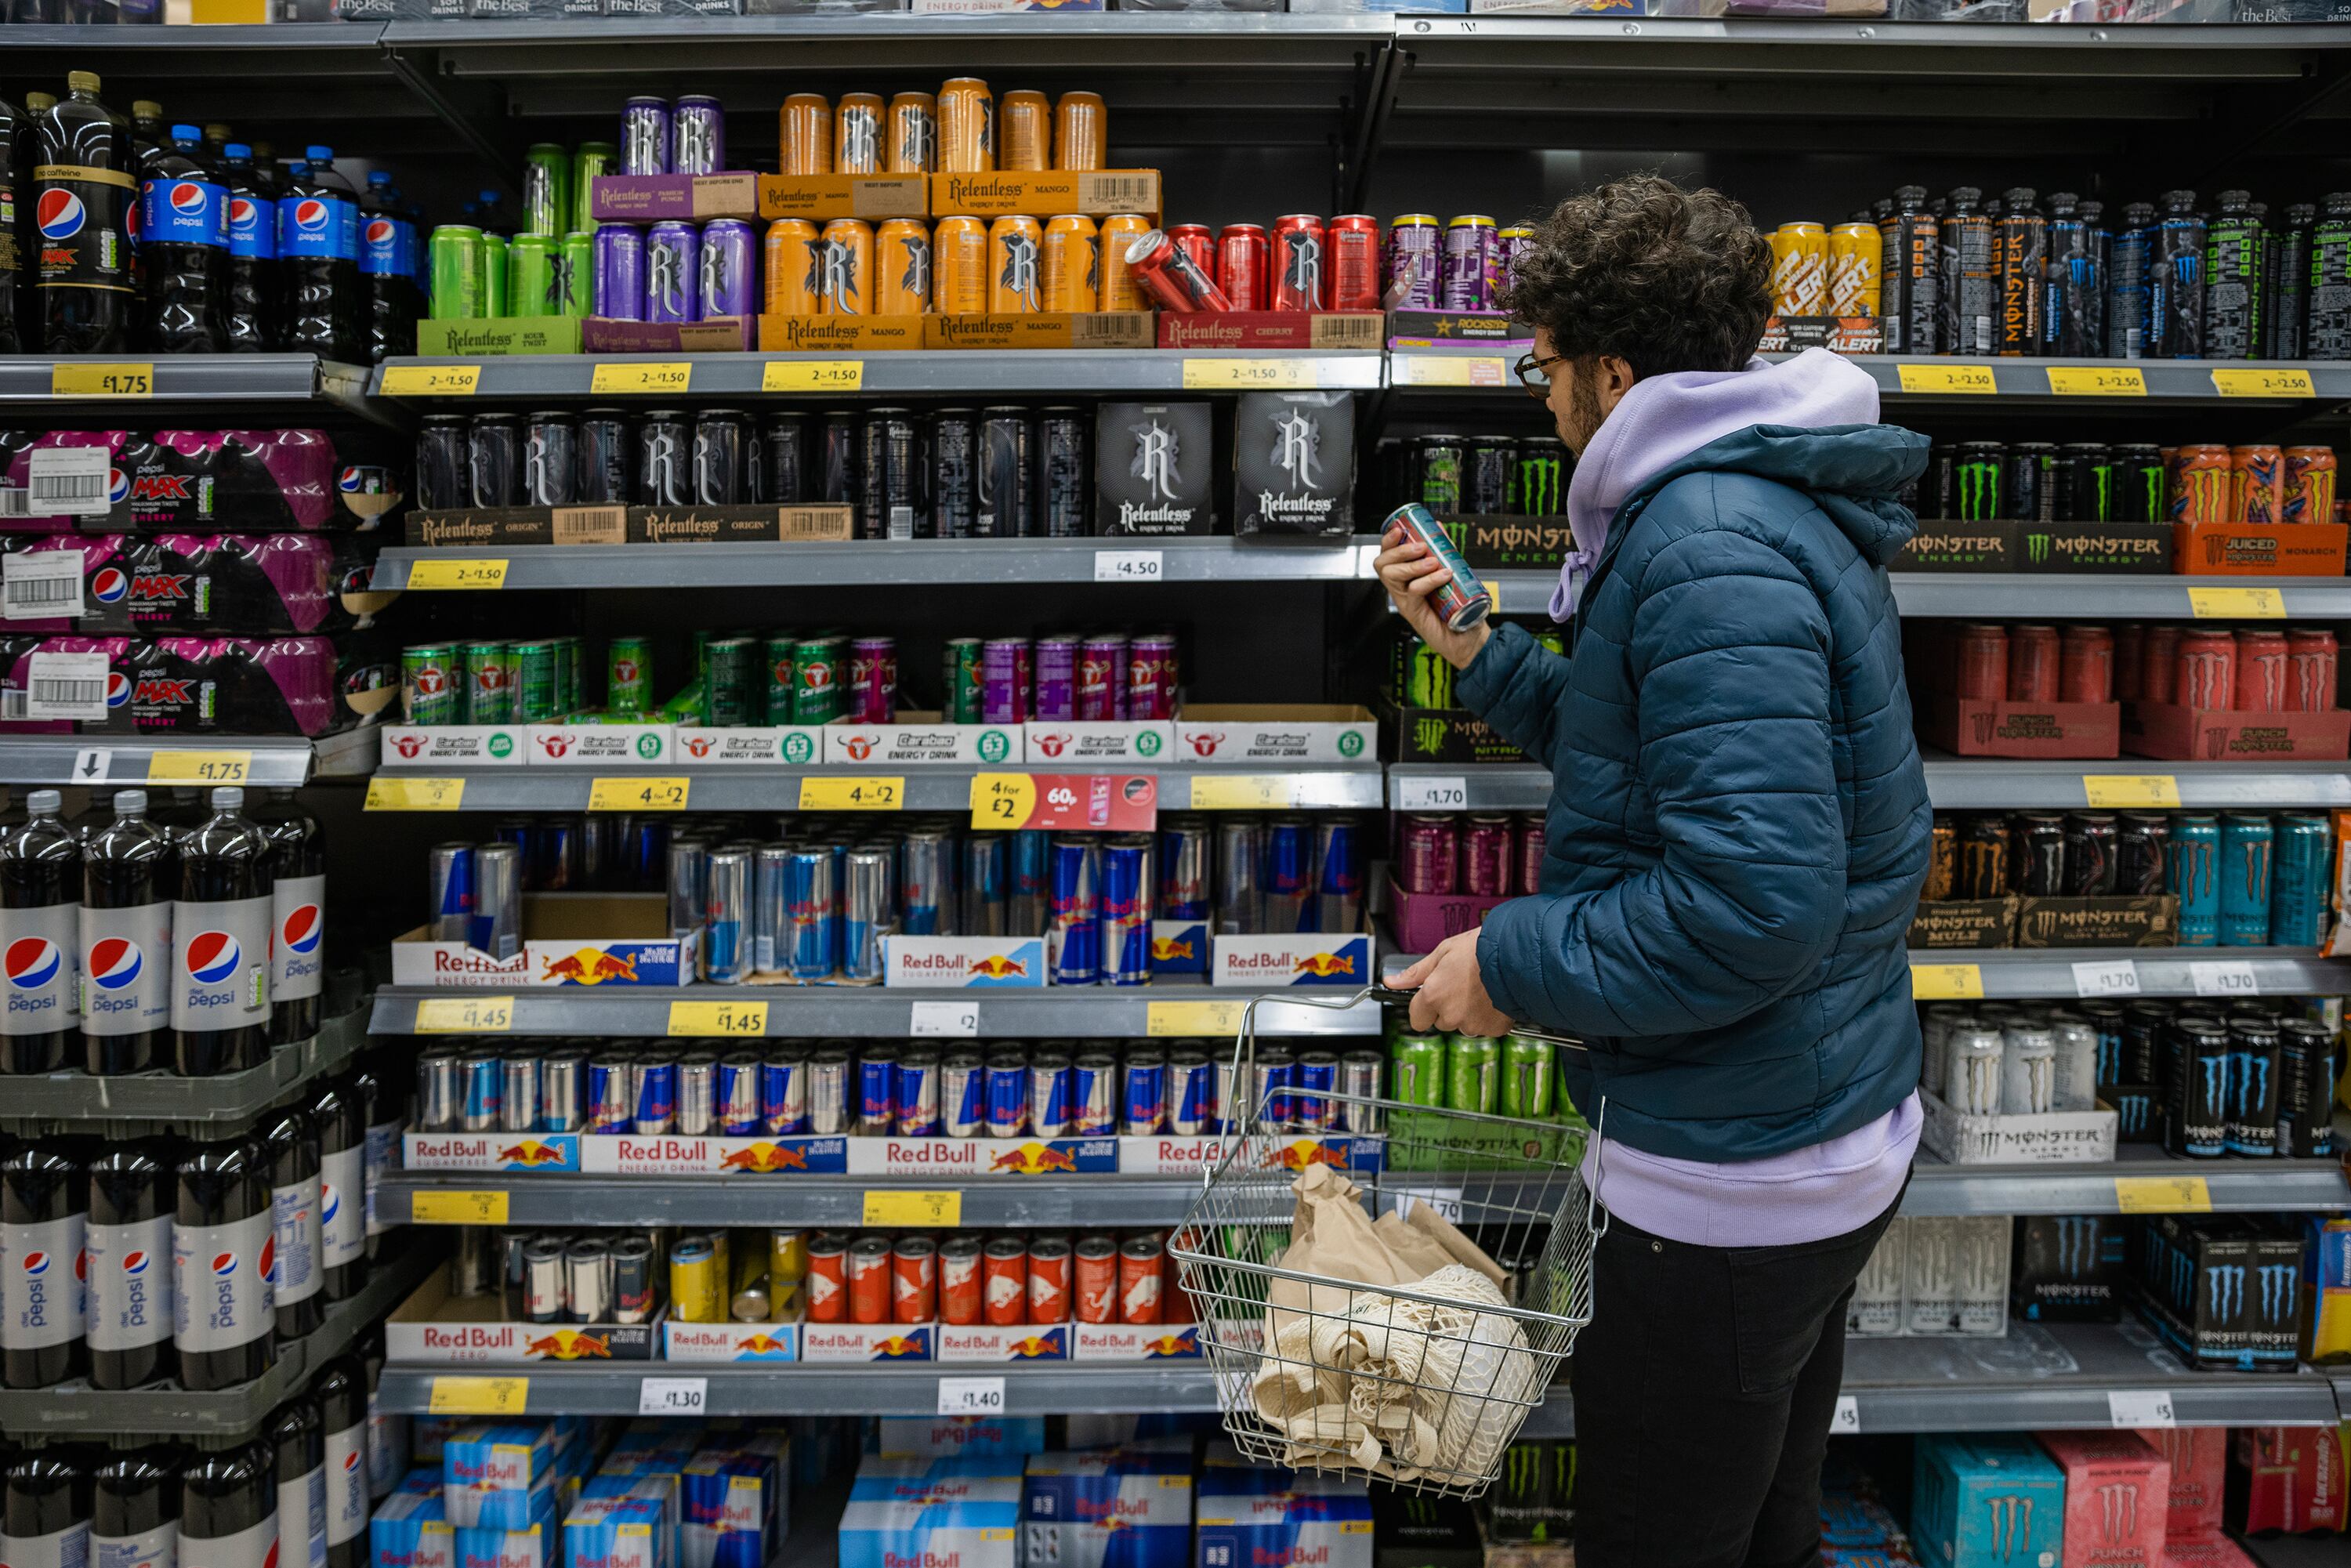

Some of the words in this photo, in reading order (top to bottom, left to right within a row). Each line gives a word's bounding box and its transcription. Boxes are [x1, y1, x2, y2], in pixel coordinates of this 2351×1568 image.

[564, 3, 599, 13] DRINKS
[634, 1, 663, 13] Best
[2242, 8, 2262, 22] the
[2265, 9, 2292, 22] Best
[601, 186, 652, 208] Relentless
[768, 188, 819, 208] Relentless
[949, 175, 1023, 208] Relentless
[173, 217, 203, 228] pepsi
[298, 233, 325, 242] pepsi
[41, 249, 78, 264] MAX
[2006, 234, 2025, 342] MONSTER
[787, 315, 860, 349] Relentless
[940, 315, 1015, 345] Relentless
[1168, 315, 1244, 347] Relentless
[446, 327, 512, 355] Relentless
[1827, 338, 1882, 351] ALERT
[429, 375, 437, 385] 2
[446, 375, 473, 385] £1.50
[642, 373, 648, 382] 2
[657, 373, 685, 382] £1.50
[812, 370, 819, 379] 2
[829, 370, 857, 379] £1.50
[1233, 368, 1240, 378] 2
[1249, 368, 1277, 378] £1.50
[1947, 375, 1954, 384] 2
[1962, 375, 1989, 384] £2.50
[103, 376, 147, 394] £1.75
[2097, 377, 2104, 386] 2
[2112, 377, 2139, 386] £2.50
[2263, 378, 2270, 388] 2
[2278, 378, 2306, 388] £2.50
[1279, 407, 1322, 490] R
[1139, 418, 1182, 500] R
[137, 464, 165, 474] pepsi
[132, 475, 195, 499] MAX
[1259, 490, 1332, 520] Relentless
[1119, 500, 1191, 534] Relentless
[421, 516, 494, 546] Relentless
[505, 523, 538, 532] ORIGIN
[646, 515, 719, 542] Relentless
[731, 520, 765, 530] ORIGIN
[1903, 534, 2003, 552] MONSTER
[2055, 534, 2161, 553] MONSTER
[2227, 538, 2277, 550] JUICED
[2074, 555, 2142, 563] ENERGY
[135, 563, 162, 574] pepsi
[458, 570, 465, 579] 2
[474, 570, 501, 579] £1.50
[1117, 560, 1157, 576] £4.50
[128, 574, 192, 599] MAX
[138, 667, 166, 679] pepsi
[132, 679, 196, 704] MAX
[787, 740, 808, 755] 63
[897, 734, 955, 747] Carabao
[982, 737, 1003, 752] 63
[429, 749, 455, 759] ENERGY
[458, 748, 479, 757] DRINK
[888, 751, 925, 760] ENERGY
[929, 751, 958, 759] DRINK
[1475, 746, 1522, 755] NITRO
[199, 763, 242, 780] £1.75
[639, 788, 651, 802] 4
[666, 787, 682, 802] £2
[850, 788, 861, 802] 4
[877, 786, 893, 802] £2
[991, 782, 1001, 794] 4
[1003, 786, 1020, 795] for
[1427, 790, 1463, 803] £1.70
[1047, 788, 1077, 806] 60p
[993, 798, 1015, 818] £2
[1103, 896, 1128, 913] Red
[1914, 916, 1995, 929] MONSTER
[2059, 910, 2148, 925] MONSTER
[1928, 931, 1981, 941] MULE
[904, 954, 932, 969] Red
[936, 954, 964, 969] Bull
[1229, 954, 1258, 969] Red
[1262, 953, 1290, 969] Bull
[286, 962, 320, 980] pepsi
[2099, 972, 2135, 989] £1.70
[2218, 974, 2251, 989] £1.70
[8, 994, 56, 1013] pepsi
[92, 996, 138, 1013] pepsi
[188, 990, 234, 1009] pepsi
[464, 1009, 506, 1027] £1.45
[719, 1013, 761, 1031] £1.45
[961, 1015, 975, 1030] £2
[2004, 1128, 2099, 1144] MONSTER
[417, 1141, 448, 1157] Red
[454, 1141, 486, 1156] Bull
[618, 1140, 660, 1161] Red
[666, 1140, 706, 1160] Bull
[887, 1143, 929, 1163] Red
[936, 1143, 976, 1163] Bull
[1159, 1142, 1201, 1161] Red
[2036, 1284, 2110, 1299] MONSTER
[30, 1278, 46, 1327] pepsi
[131, 1277, 147, 1327] pepsi
[219, 1280, 237, 1327] pepsi
[425, 1327, 466, 1348] Red
[470, 1327, 513, 1347] Bull
[674, 1333, 698, 1345] Red
[701, 1333, 727, 1345] Bull
[809, 1334, 833, 1348] Red
[837, 1334, 863, 1348] Bull
[944, 1336, 969, 1349] Red
[973, 1336, 999, 1349] Bull
[1081, 1335, 1105, 1349] Red
[1109, 1335, 1136, 1348] Bull
[451, 1352, 487, 1360] ZERO
[666, 1391, 700, 1407] £1.30
[963, 1392, 999, 1407] £1.40
[2157, 1405, 2171, 1419] £5
[455, 1461, 482, 1478] Red
[487, 1461, 517, 1479] Bull
[692, 1501, 718, 1519] Red
[722, 1502, 751, 1520] Bull
[1077, 1498, 1110, 1515] Red
[1114, 1498, 1149, 1515] Bull
[885, 1552, 918, 1568] Red
[924, 1552, 960, 1568] Bull
[1254, 1548, 1289, 1565] Red
[1294, 1547, 1328, 1565] Bull
